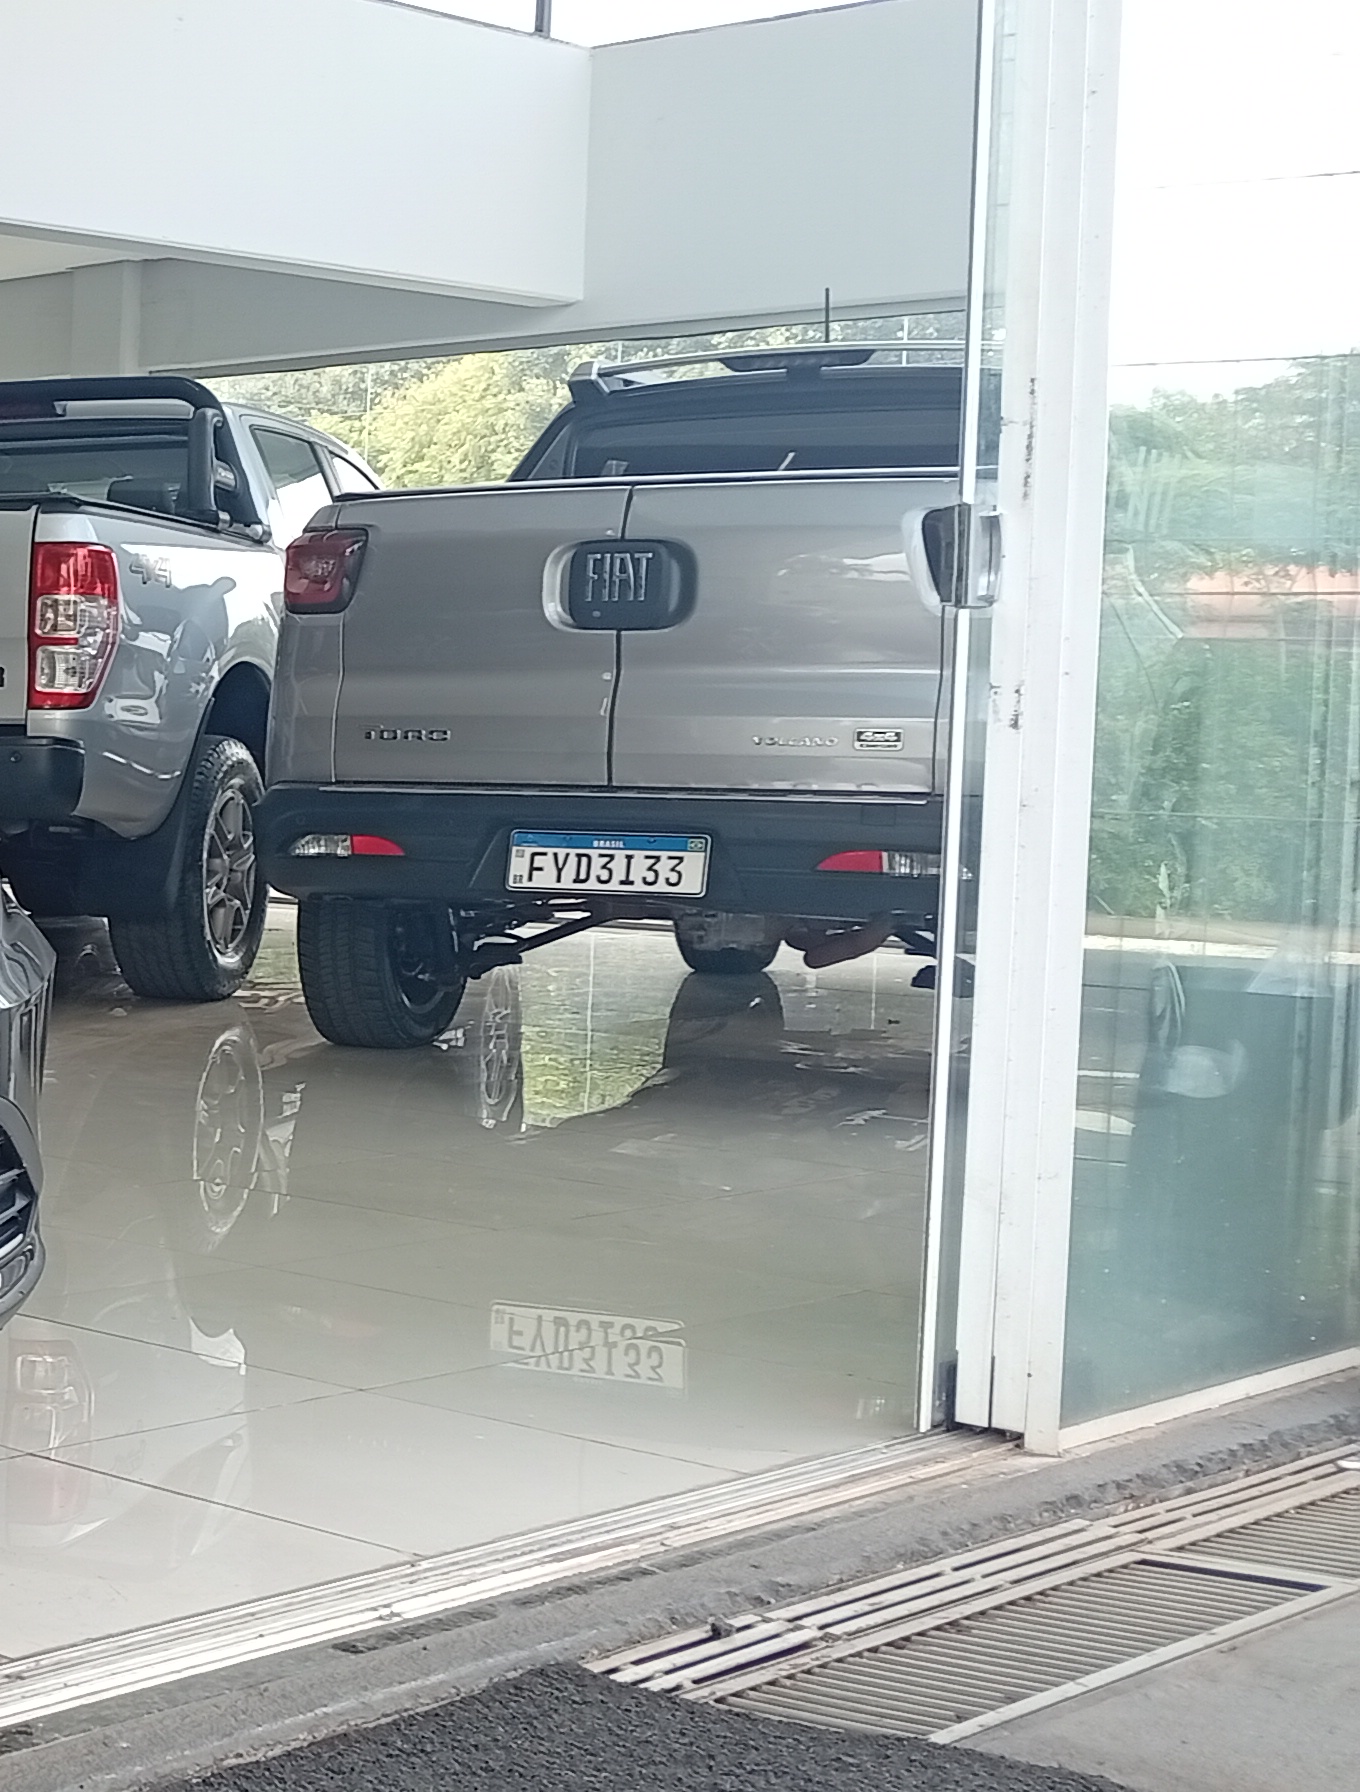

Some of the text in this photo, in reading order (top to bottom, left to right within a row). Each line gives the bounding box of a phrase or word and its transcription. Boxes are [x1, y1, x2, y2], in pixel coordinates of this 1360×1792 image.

[584, 552, 653, 602] FIAT
[592, 839, 626, 848] BRASIL
[527, 851, 685, 887] FYD3I33
